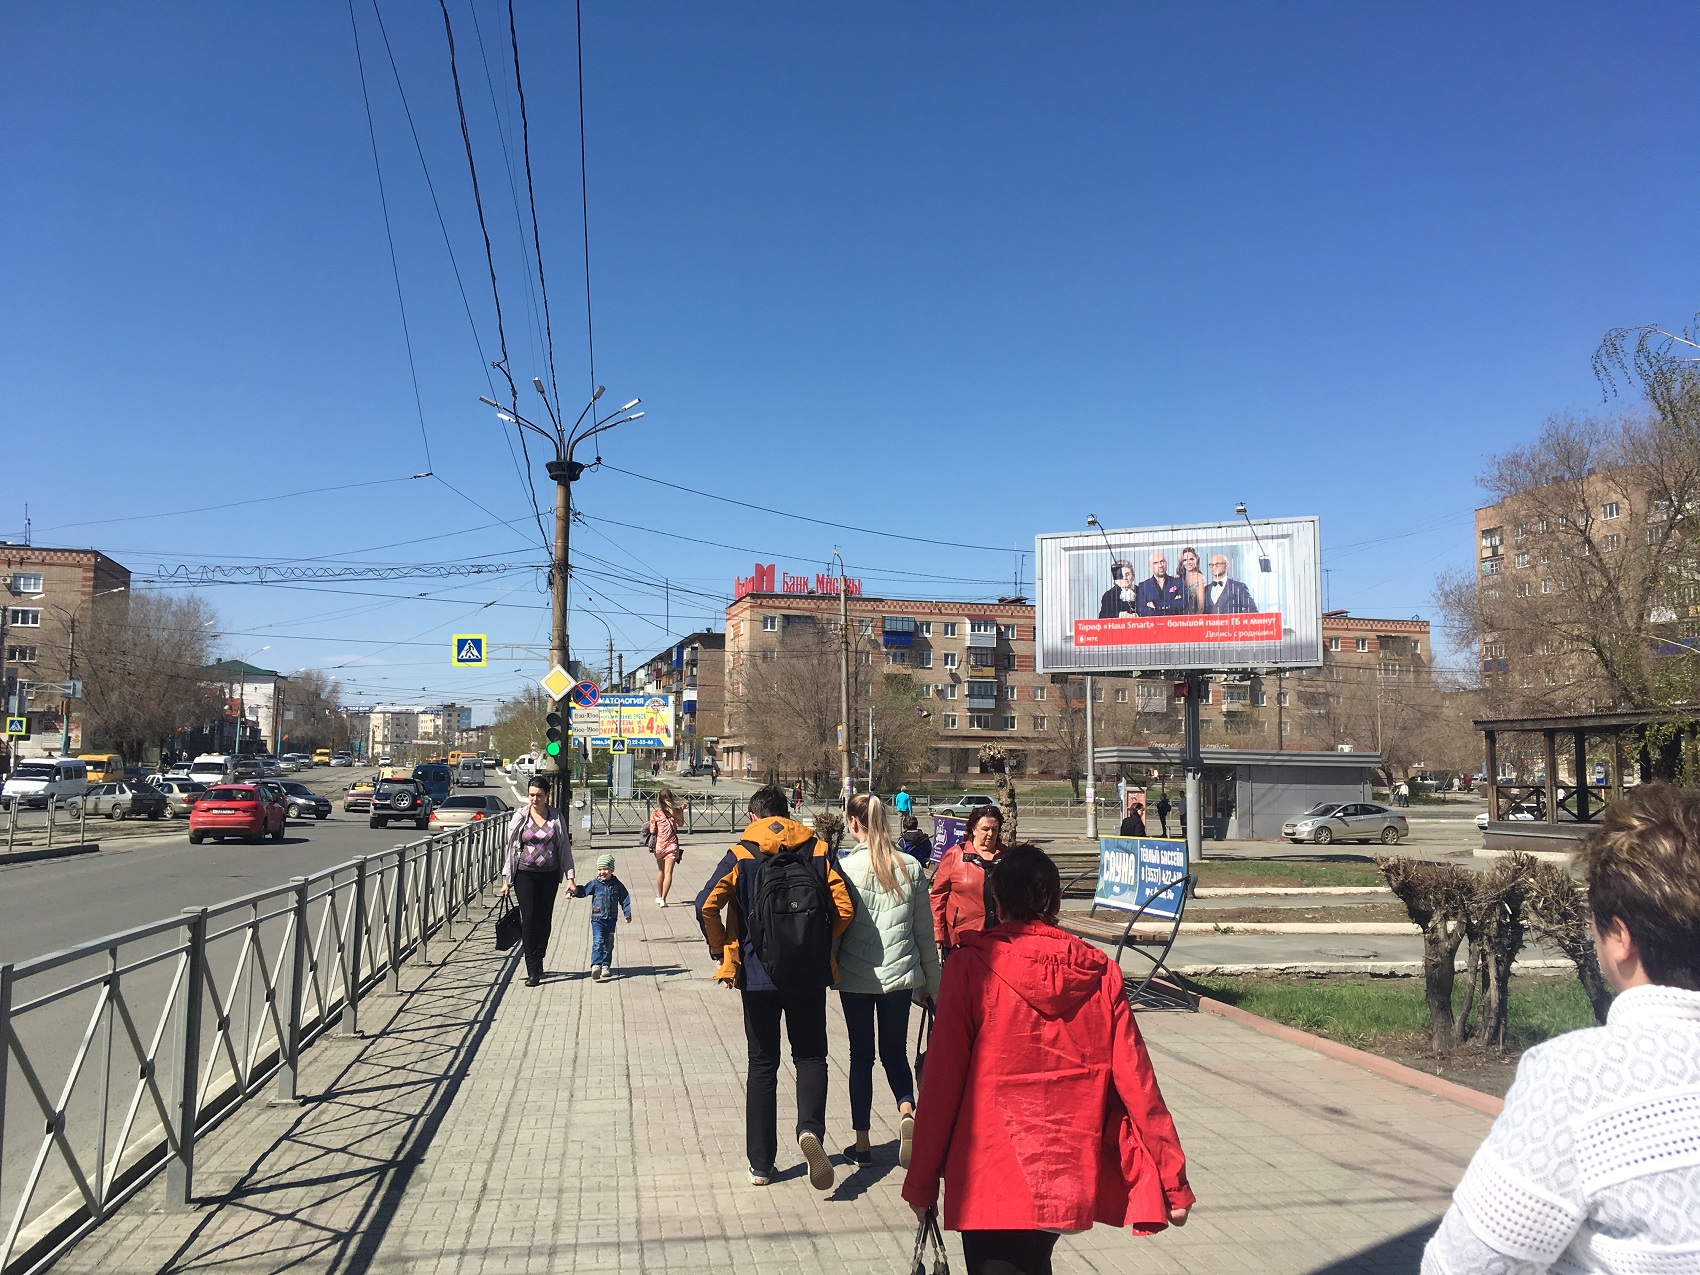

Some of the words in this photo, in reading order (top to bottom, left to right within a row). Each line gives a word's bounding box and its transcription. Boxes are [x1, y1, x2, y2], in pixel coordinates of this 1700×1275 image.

[782, 572, 809, 593] Банк
[815, 573, 862, 595] Мосвы
[1077, 622, 1102, 633] Тариф
[1103, 621, 1126, 630] «Наш
[1127, 619, 1155, 629] Smart»
[1167, 618, 1204, 628] большой
[1205, 618, 1229, 627] пакет
[1231, 617, 1240, 626] ГБ
[1249, 616, 1276, 627] минут
[1205, 630, 1232, 639] Делись
[1239, 628, 1277, 638] родными!
[646, 717, 654, 734] 4
[1103, 850, 1136, 886] САУНА
